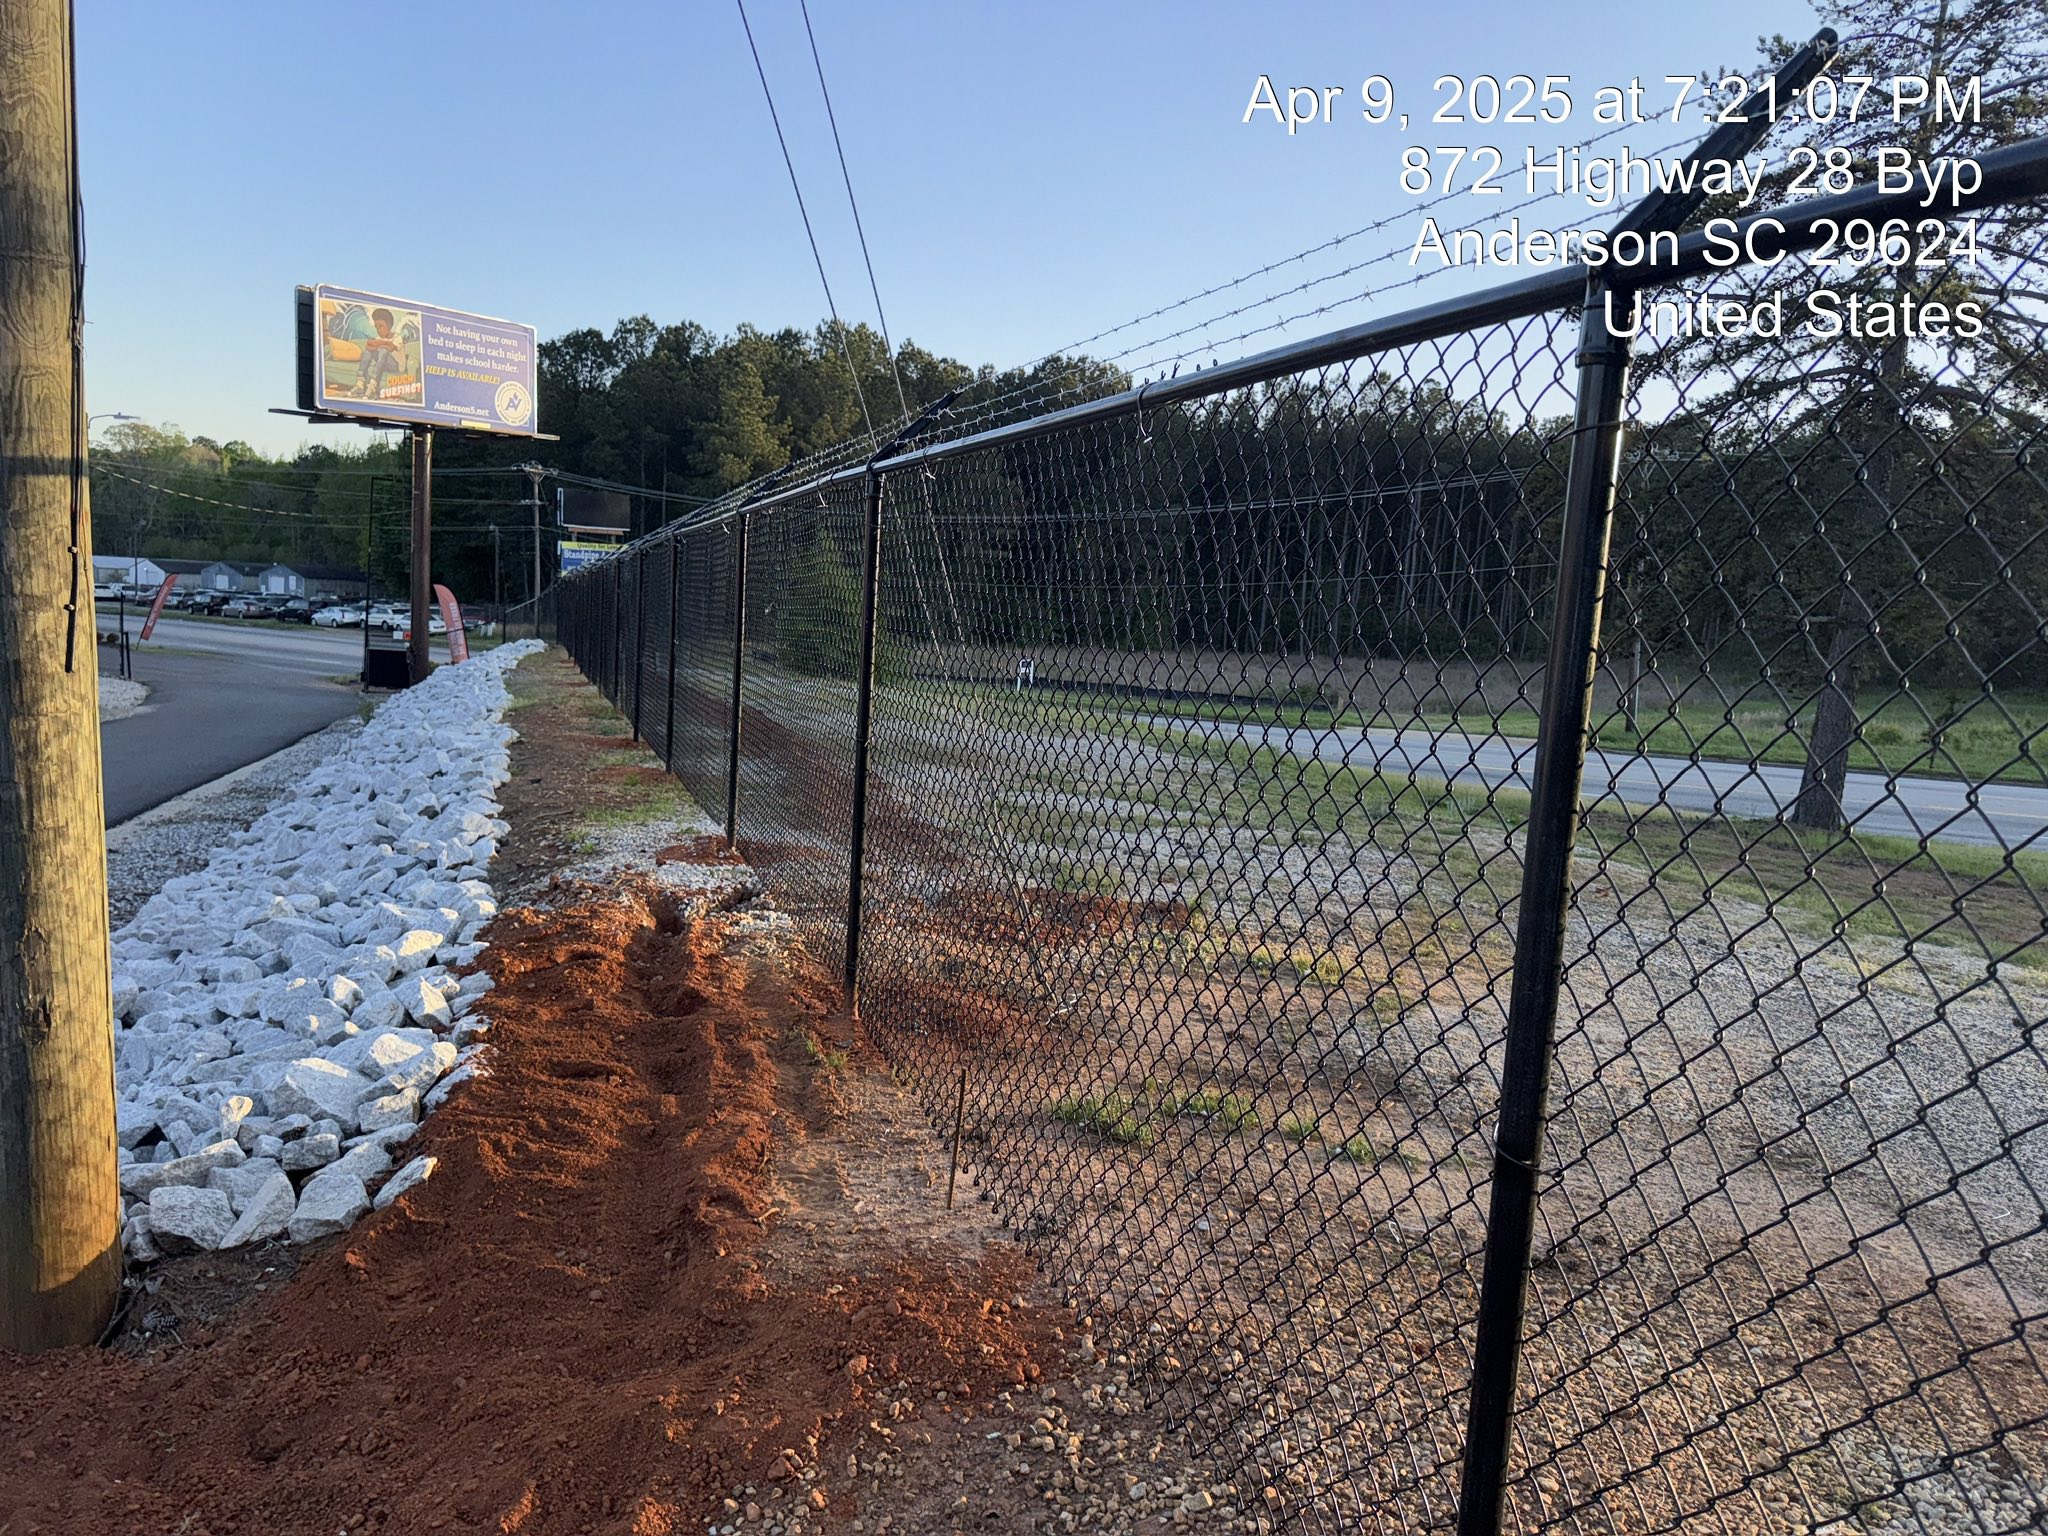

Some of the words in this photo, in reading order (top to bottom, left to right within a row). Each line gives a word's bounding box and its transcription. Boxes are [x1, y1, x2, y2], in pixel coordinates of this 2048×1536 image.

[436, 323, 452, 335] Not
[453, 326, 480, 341] having
[481, 334, 500, 343] your
[500, 338, 518, 347] own
[428, 335, 444, 347] bed
[445, 339, 454, 348] to
[455, 340, 476, 354] sleep
[477, 344, 486, 354] in
[487, 348, 505, 359] each
[506, 352, 527, 362] night
[437, 352, 464, 364] makes
[465, 357, 490, 369] school
[491, 360, 520, 373] harder.
[387, 374, 413, 387] COUCH
[425, 365, 447, 376] HELP
[447, 367, 456, 377] IS
[456, 369, 500, 385] AVAILABLE!
[380, 382, 422, 398] SURFING?
[434, 401, 489, 416] Anderson5.net
[563, 549, 600, 562] Standpipe
